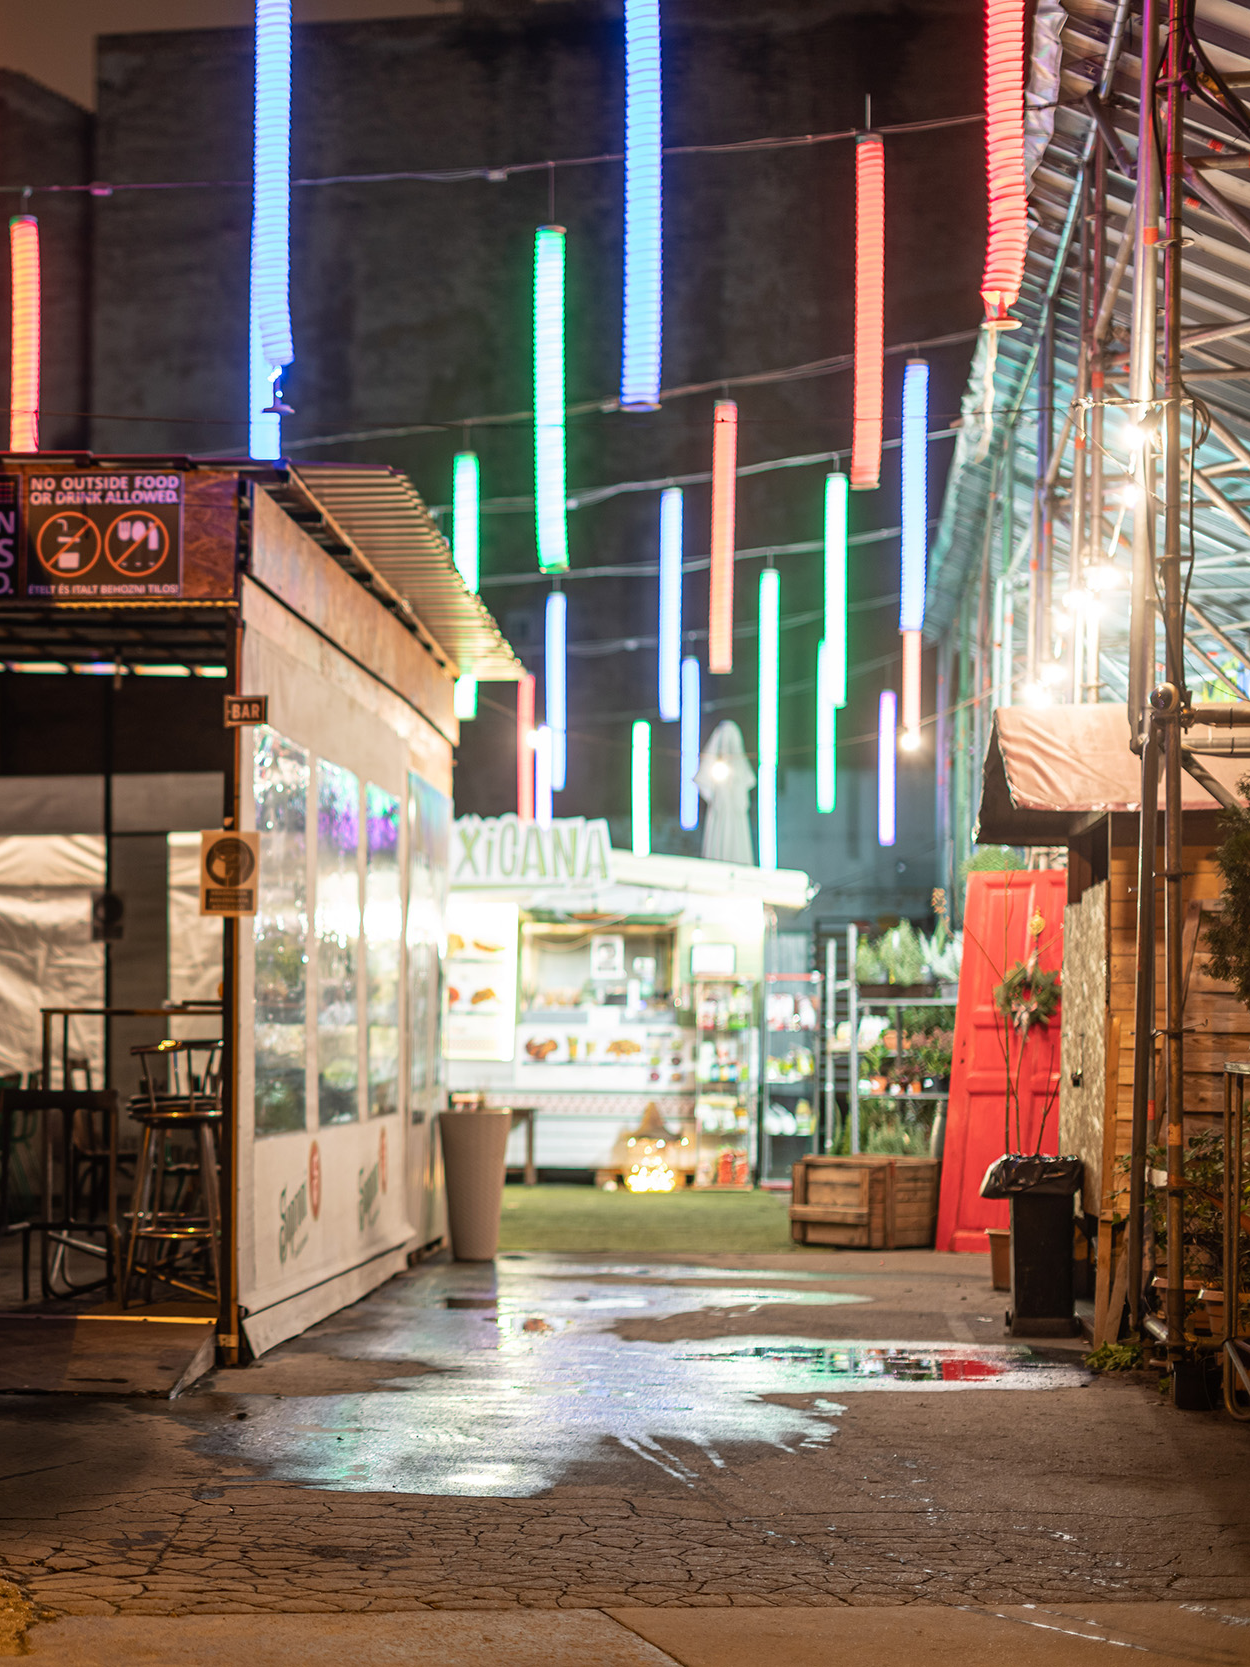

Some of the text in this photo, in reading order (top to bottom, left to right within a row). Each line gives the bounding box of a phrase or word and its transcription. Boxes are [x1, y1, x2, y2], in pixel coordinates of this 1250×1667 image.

[31, 475, 180, 490] NO OUTSIDE FOOD
[30, 489, 179, 505] OR DRINK ALLOWED.
[231, 703, 260, 719] BAR
